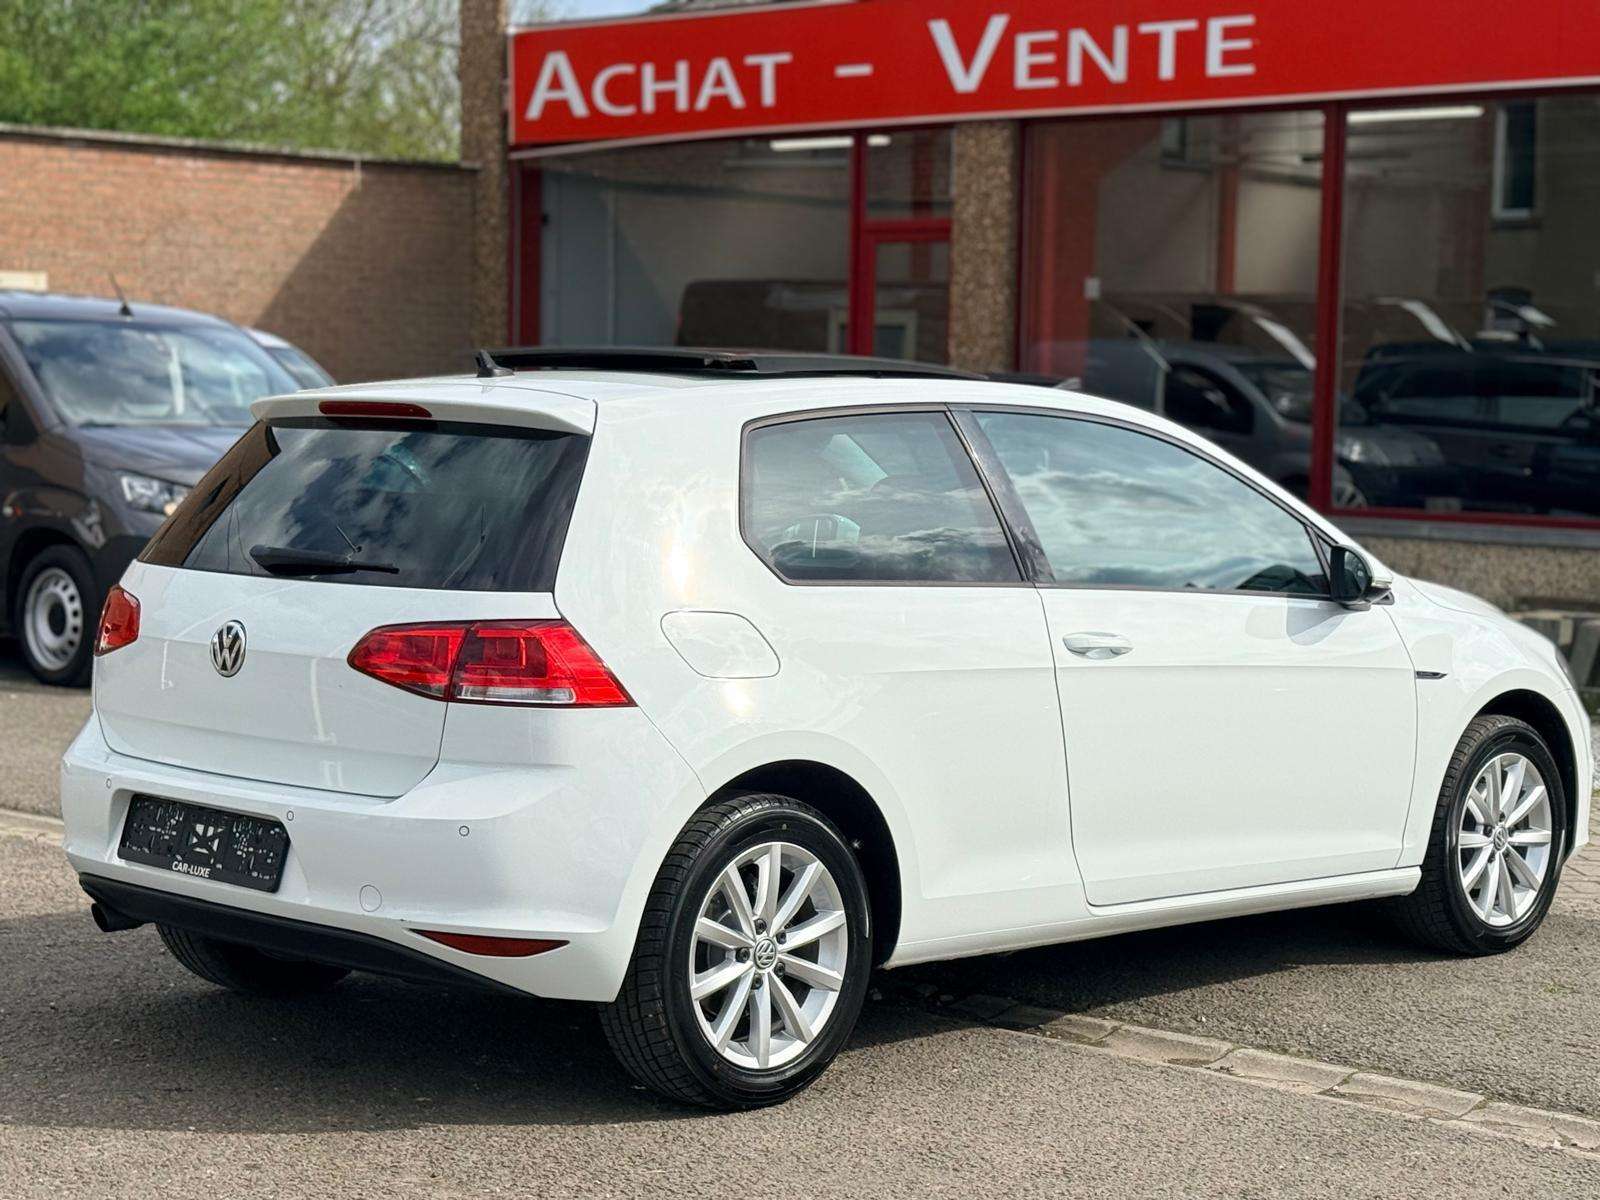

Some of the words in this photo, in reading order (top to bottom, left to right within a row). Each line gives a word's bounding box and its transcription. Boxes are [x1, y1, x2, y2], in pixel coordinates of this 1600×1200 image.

[525, 51, 793, 120] ACHAT
[928, 14, 1256, 94] VENTE
[171, 860, 211, 878] CAR-LUXE
